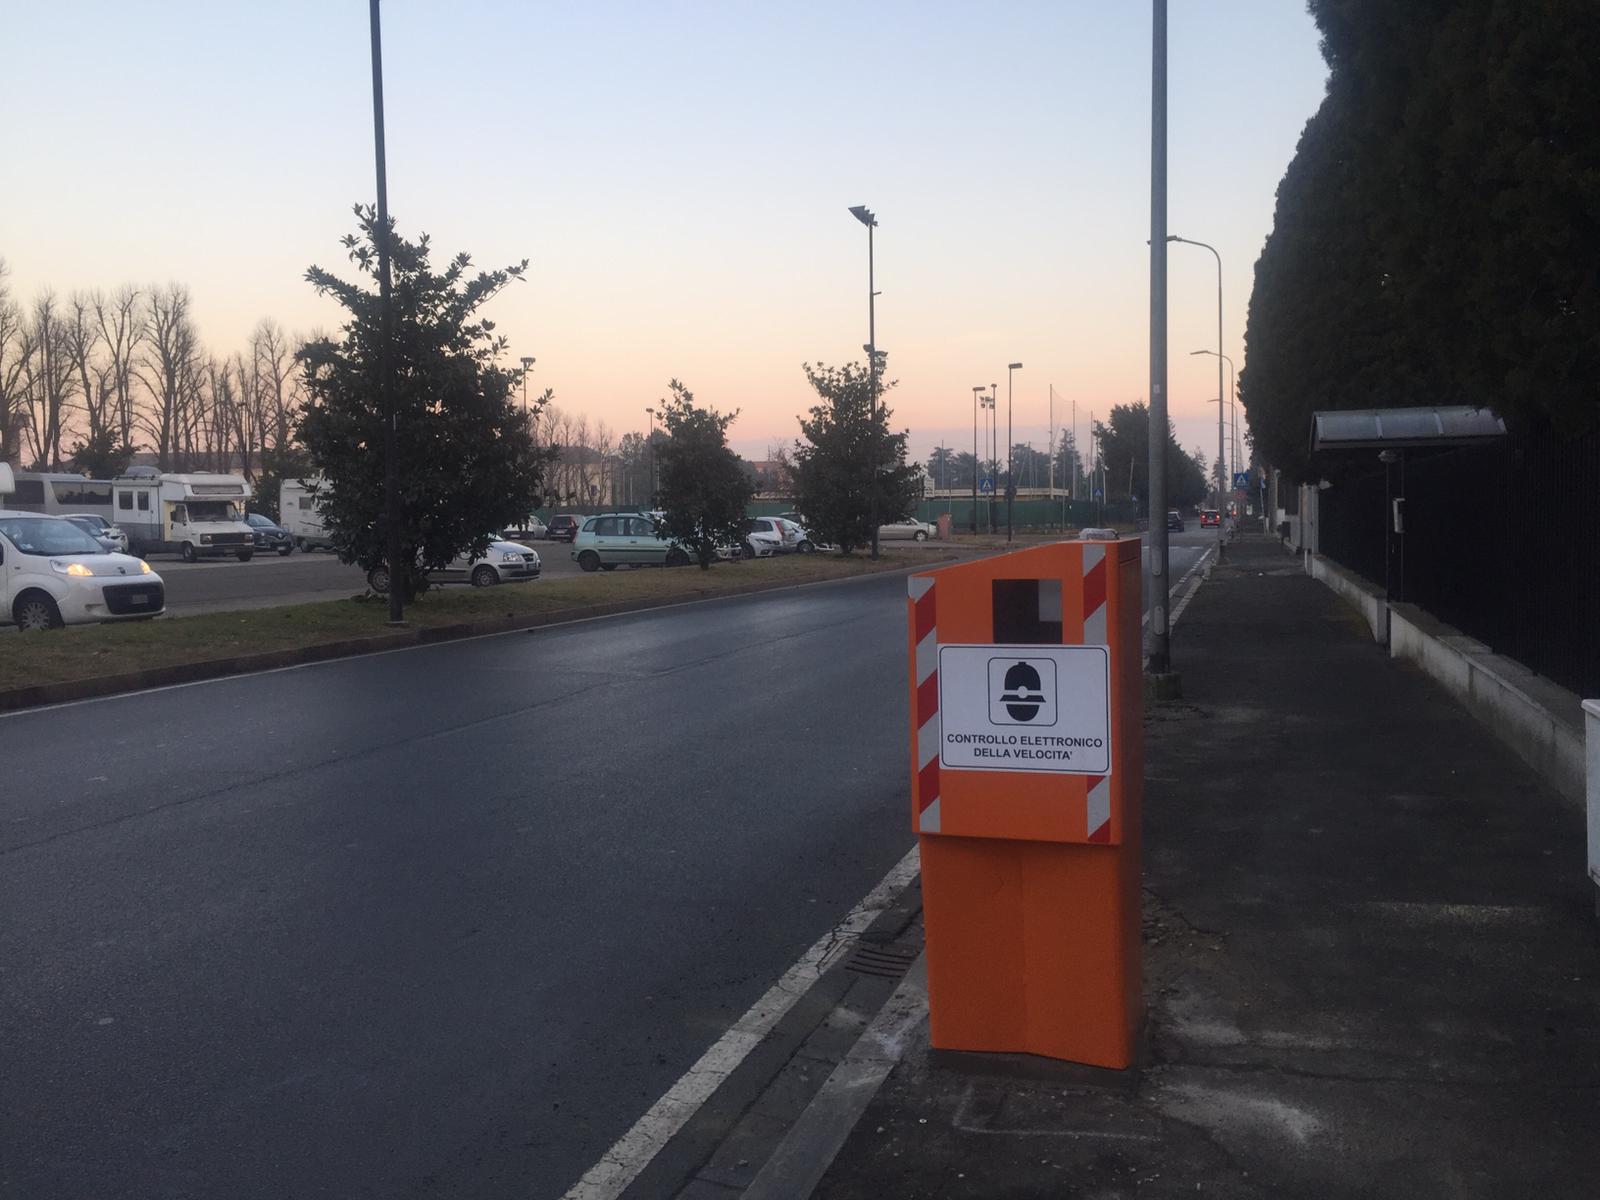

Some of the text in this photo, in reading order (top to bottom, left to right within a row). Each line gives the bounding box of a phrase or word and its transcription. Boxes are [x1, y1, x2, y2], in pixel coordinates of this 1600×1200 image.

[947, 733, 1103, 748] CONTROLLO ELETTRONICO
[974, 748, 1073, 760] DELLA VELOCITA'
